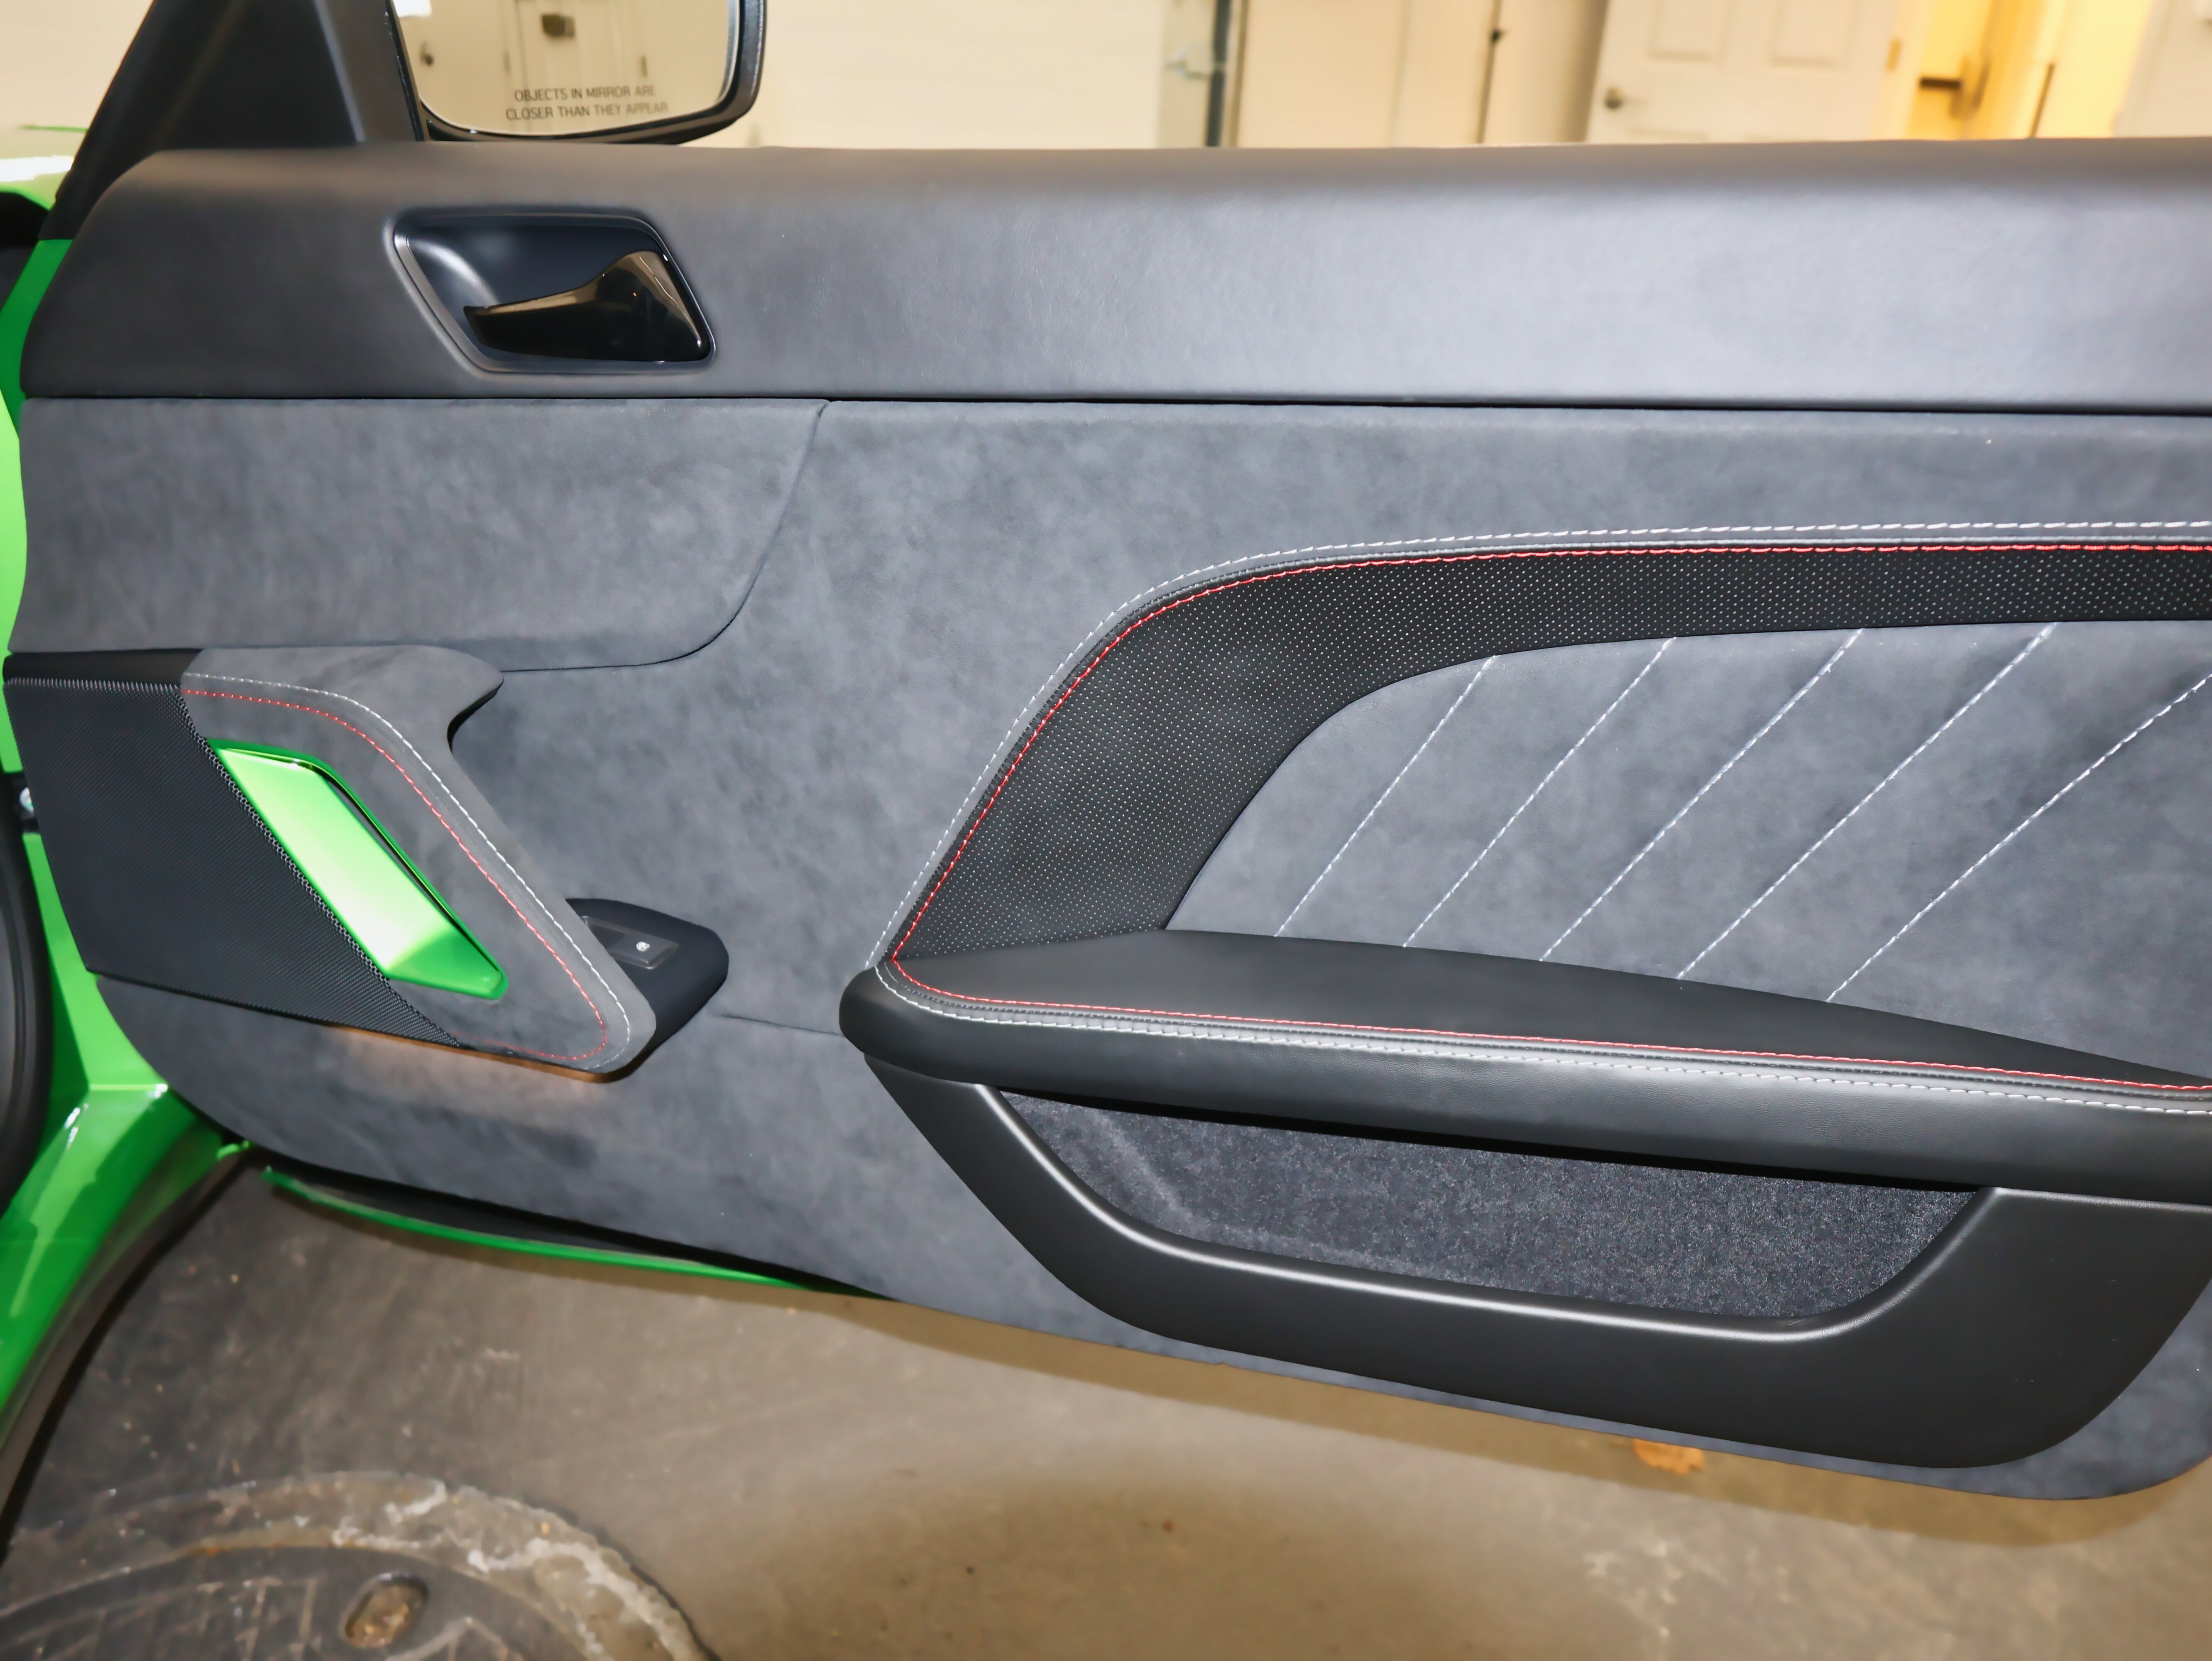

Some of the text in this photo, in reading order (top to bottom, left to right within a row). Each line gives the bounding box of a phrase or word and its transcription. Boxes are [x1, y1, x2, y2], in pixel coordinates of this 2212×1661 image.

[514, 85, 656, 102] OBJECTS IN MIRROR ARE
[506, 101, 668, 120] CLOSER THAN THEY APPEAR
